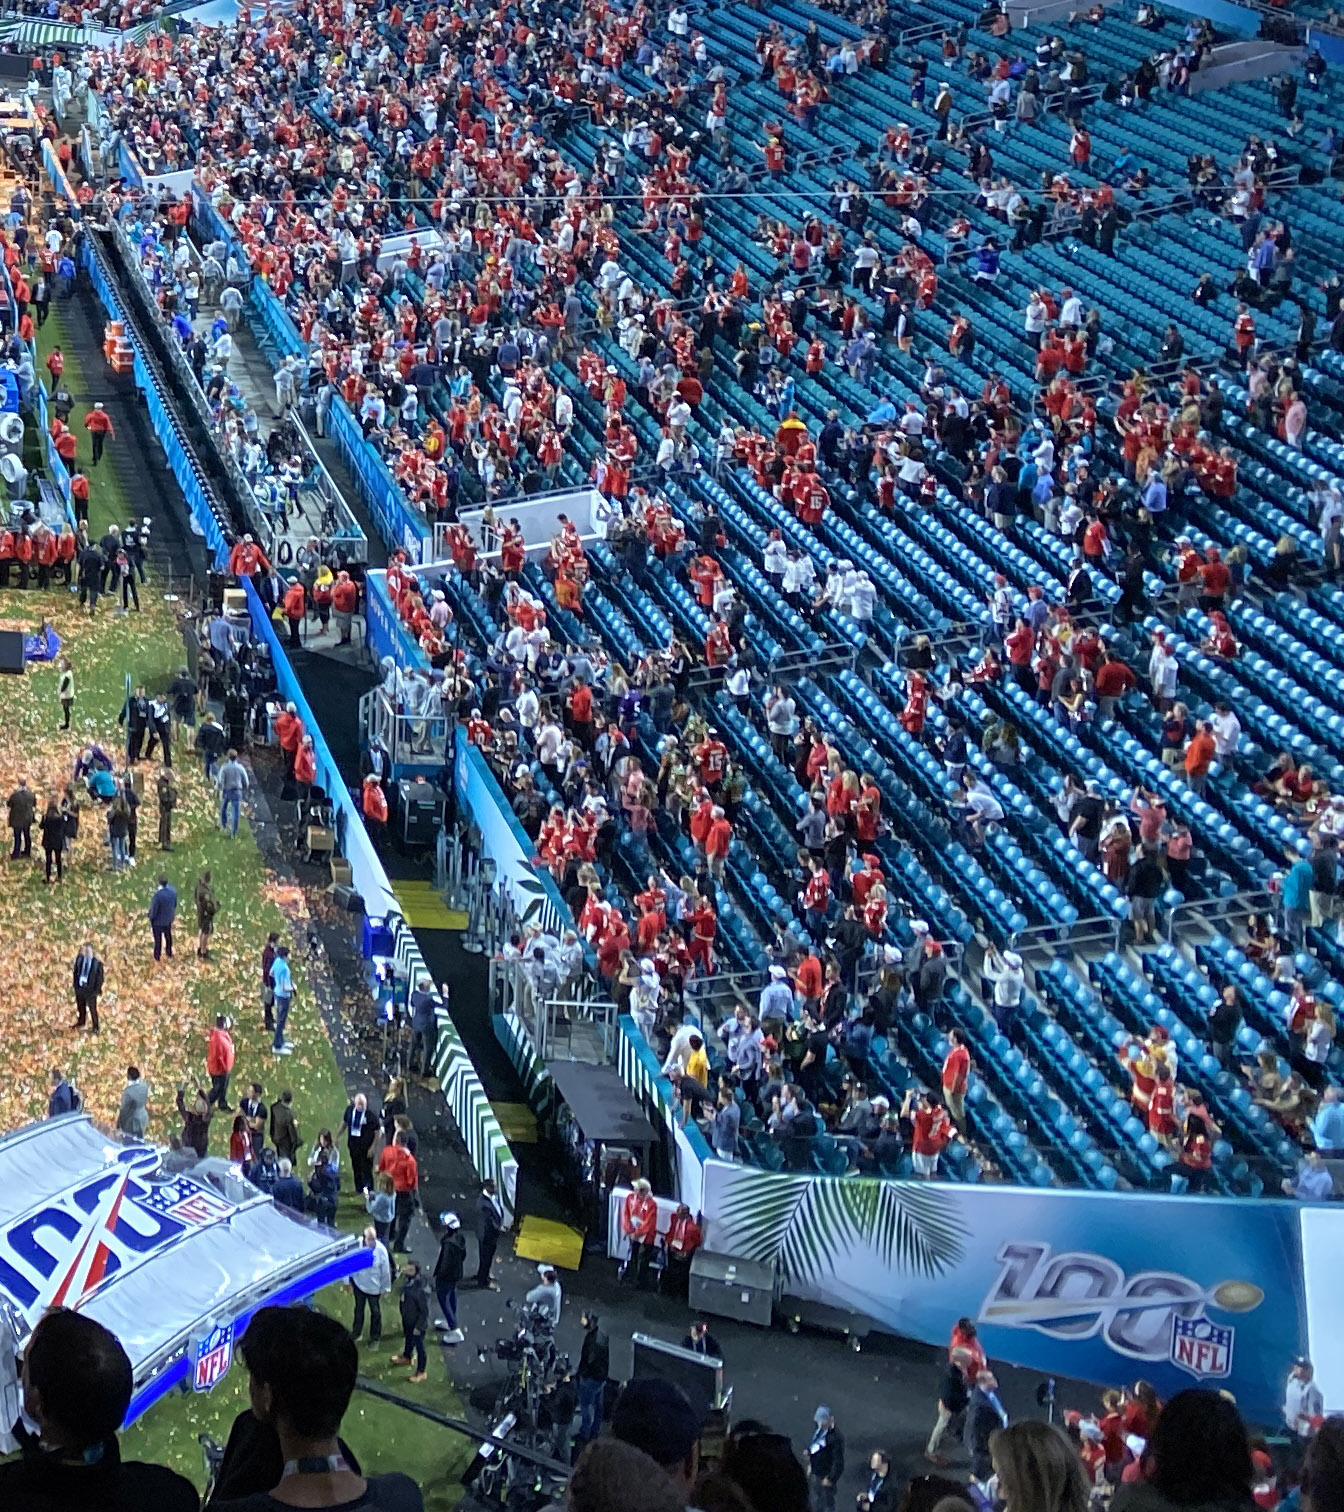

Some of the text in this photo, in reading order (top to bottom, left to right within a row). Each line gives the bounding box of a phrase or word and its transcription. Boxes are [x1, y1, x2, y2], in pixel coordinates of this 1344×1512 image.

[169, 1195, 235, 1226] NFL
[978, 1240, 1205, 1361] 100
[197, 1341, 230, 1387] NFL
[1175, 1336, 1225, 1372] NFL
